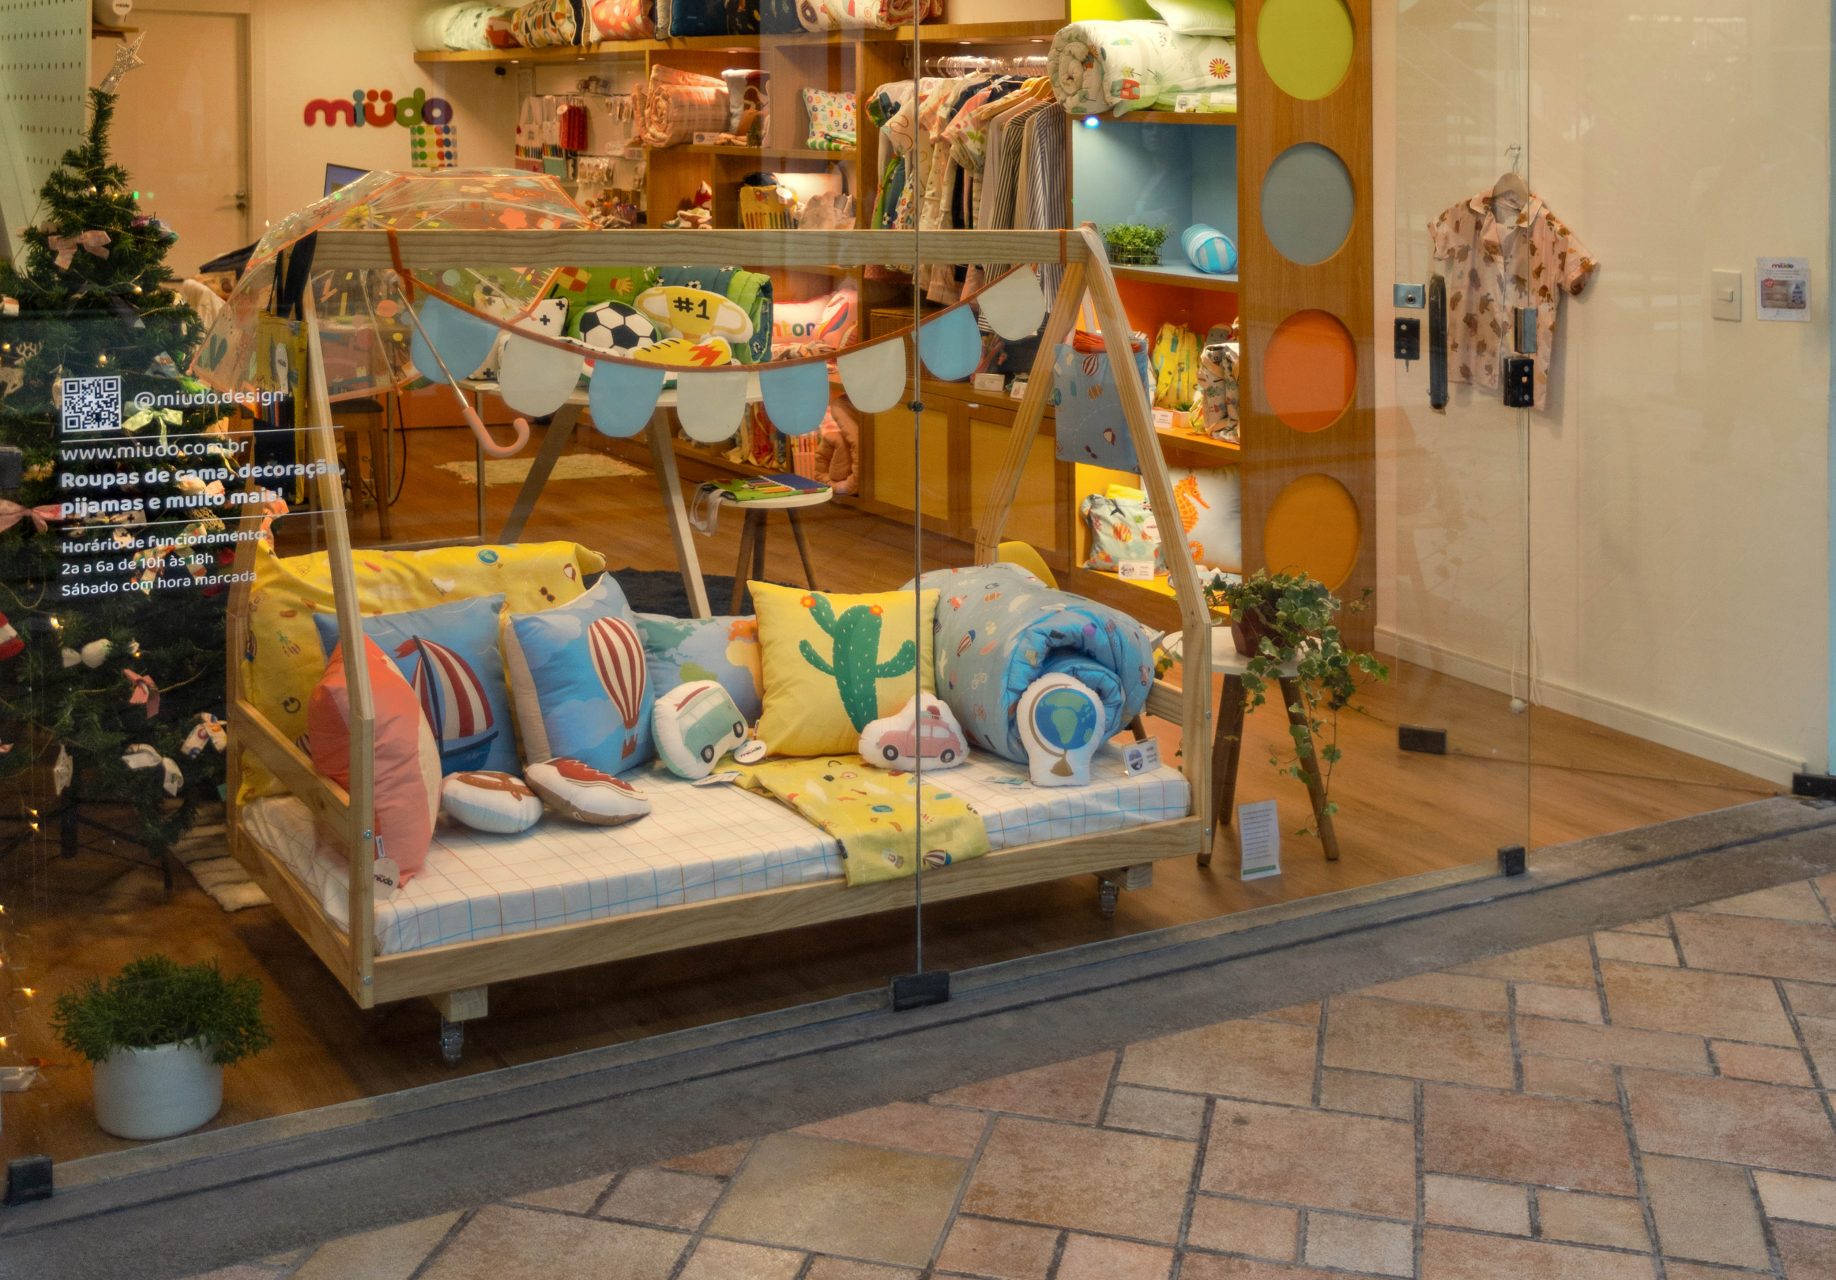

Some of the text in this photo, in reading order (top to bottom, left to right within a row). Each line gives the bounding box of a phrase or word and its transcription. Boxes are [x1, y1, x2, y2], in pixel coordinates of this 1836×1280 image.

[304, 88, 453, 128] miüdo
[673, 296, 710, 320] #1
[133, 388, 284, 410] @miudo.design
[61, 439, 248, 461] www.miudo.com.br
[61, 458, 345, 489] Roupas de cama, decoração,
[61, 487, 283, 517] pijamas e muito mais!
[62, 538, 121, 553] Horário
[126, 536, 145, 549] de
[62, 553, 214, 575] 2a a 6a de 10h às 18h
[62, 571, 256, 596] Sábado com hora marcada
